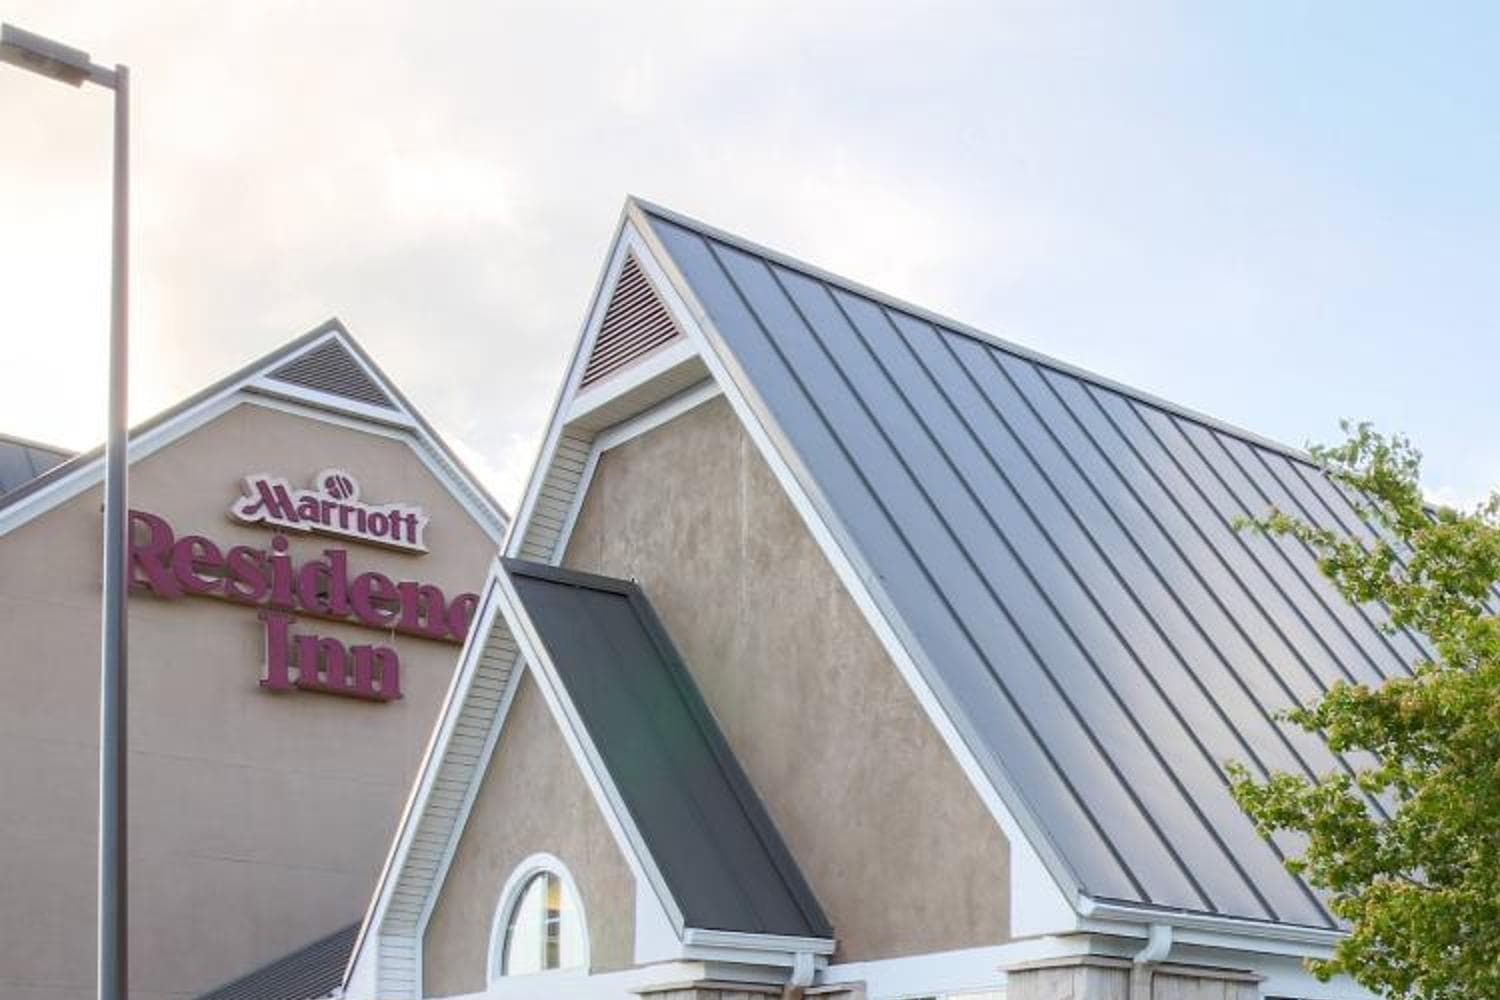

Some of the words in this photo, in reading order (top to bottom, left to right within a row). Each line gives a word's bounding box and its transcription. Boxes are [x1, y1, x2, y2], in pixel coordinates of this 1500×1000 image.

[242, 479, 419, 545] Marriott
[102, 506, 481, 642] Residenc
[258, 609, 402, 700] Inn
